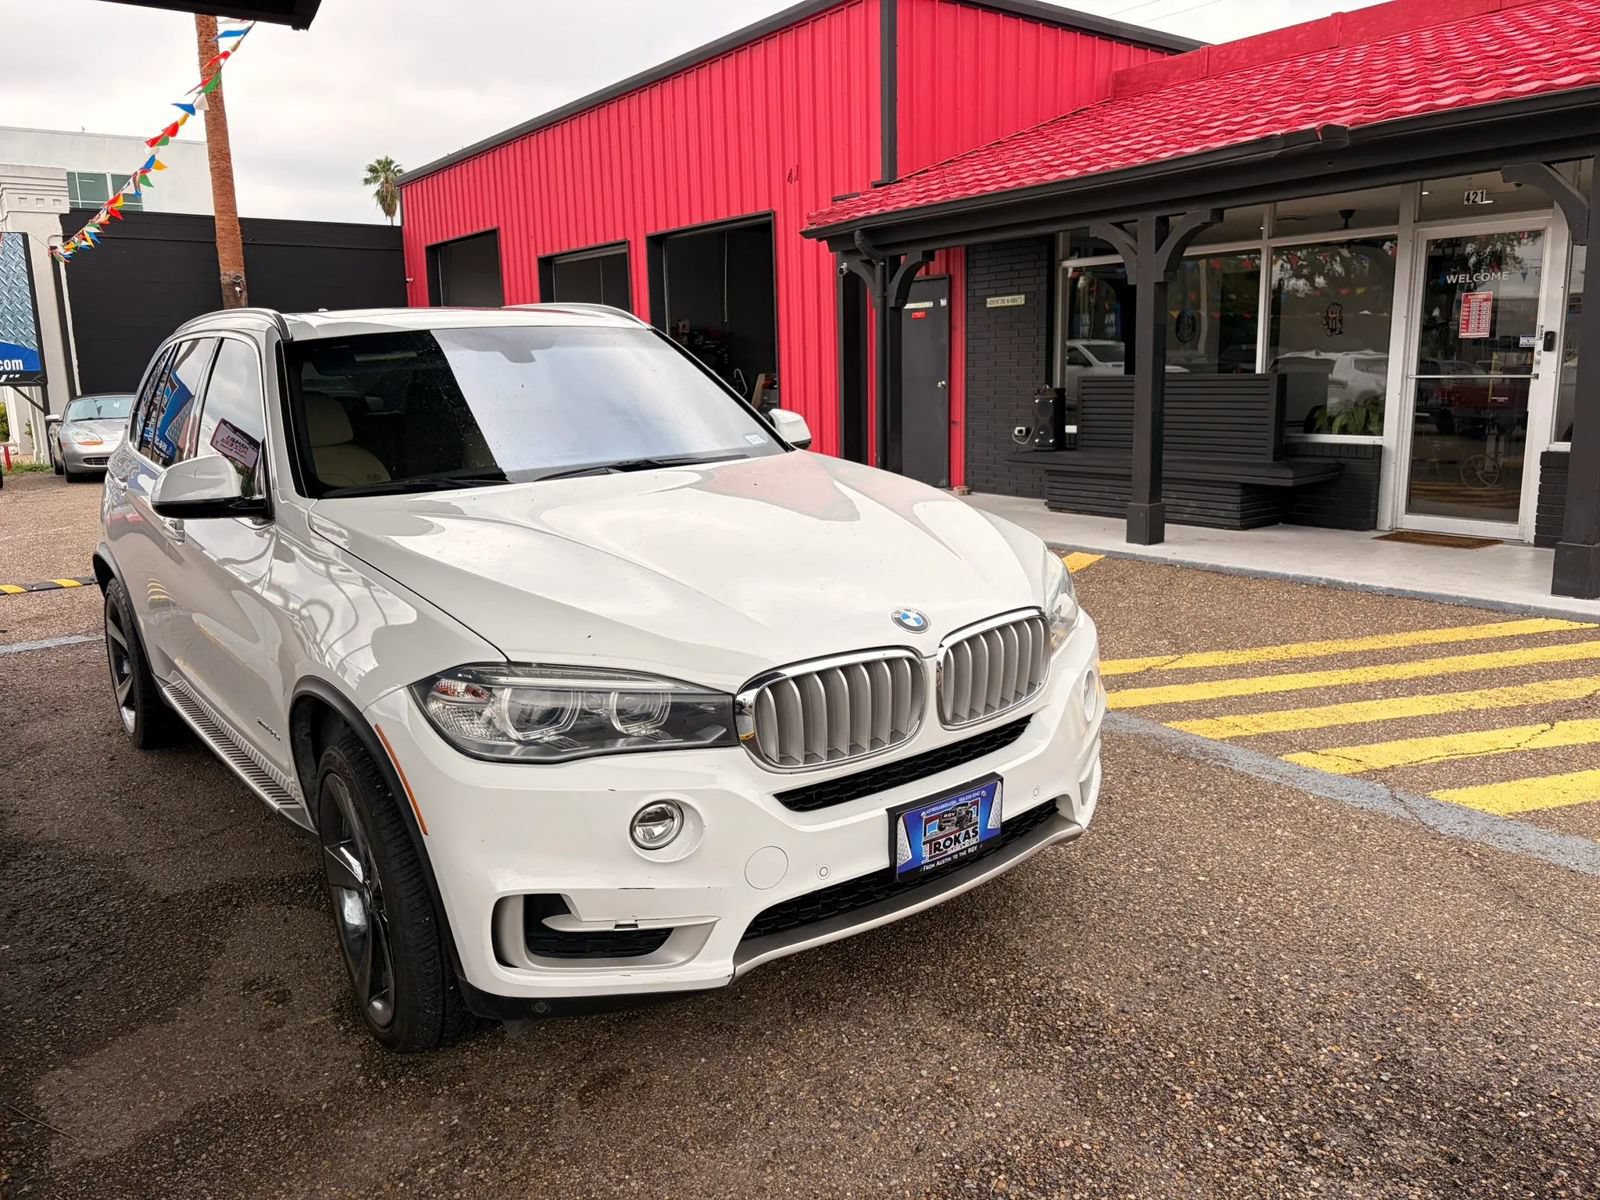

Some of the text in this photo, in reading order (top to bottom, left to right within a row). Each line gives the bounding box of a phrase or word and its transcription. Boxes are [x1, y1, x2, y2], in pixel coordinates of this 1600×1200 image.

[1465, 190, 1485, 204] 421
[1446, 271, 1510, 284] WELCOME
[922, 826, 979, 857] TROKAS
